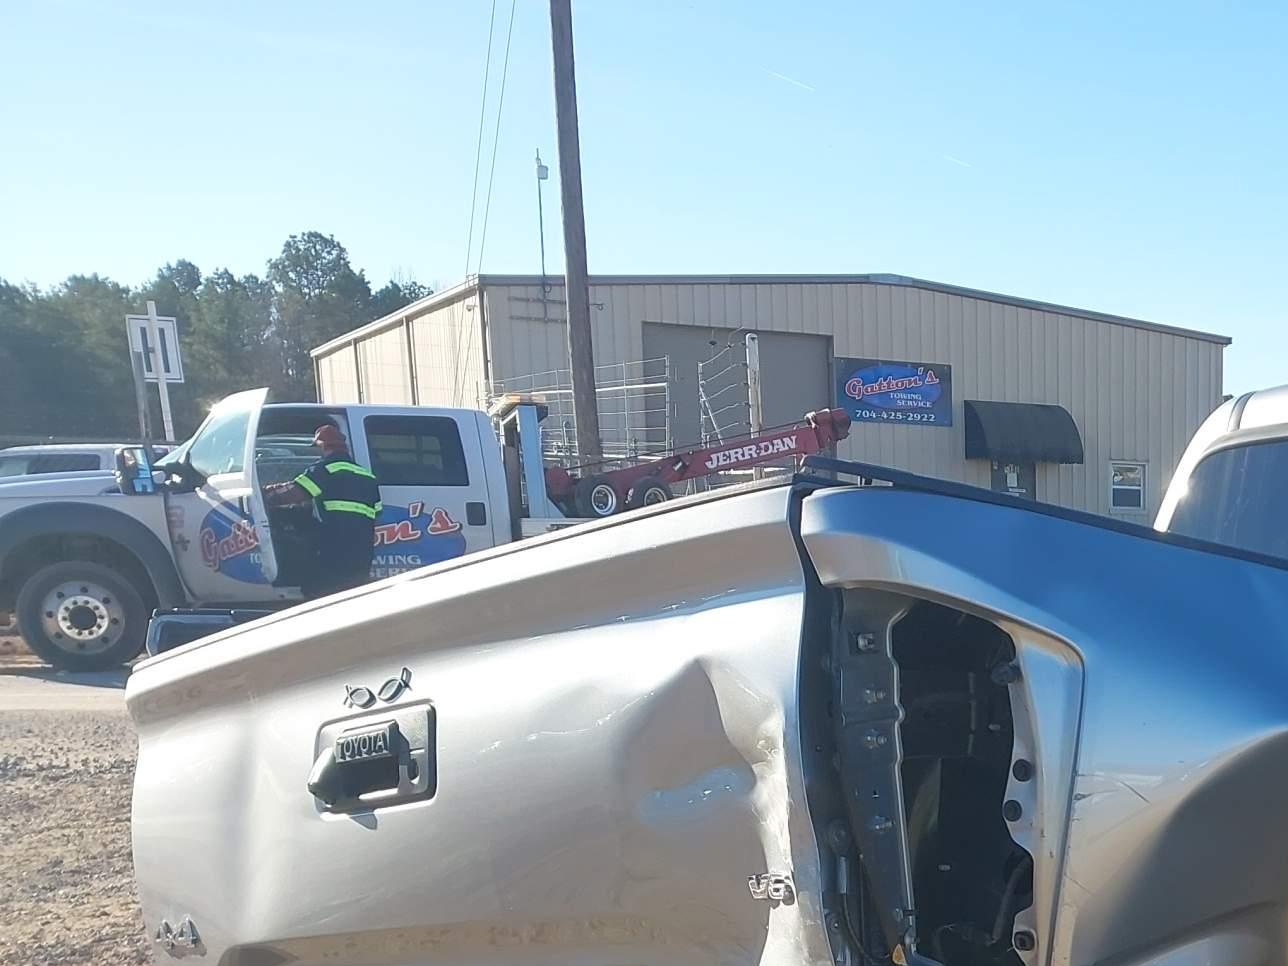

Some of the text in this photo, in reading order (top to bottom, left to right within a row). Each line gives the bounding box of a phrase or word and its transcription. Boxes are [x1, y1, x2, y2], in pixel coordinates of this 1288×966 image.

[845, 367, 940, 400] Gatton's
[889, 392, 922, 401] TOWING
[896, 400, 933, 408] SERVICE
[855, 409, 936, 423] 704-425-2922
[336, 730, 388, 763] TOYOTA
